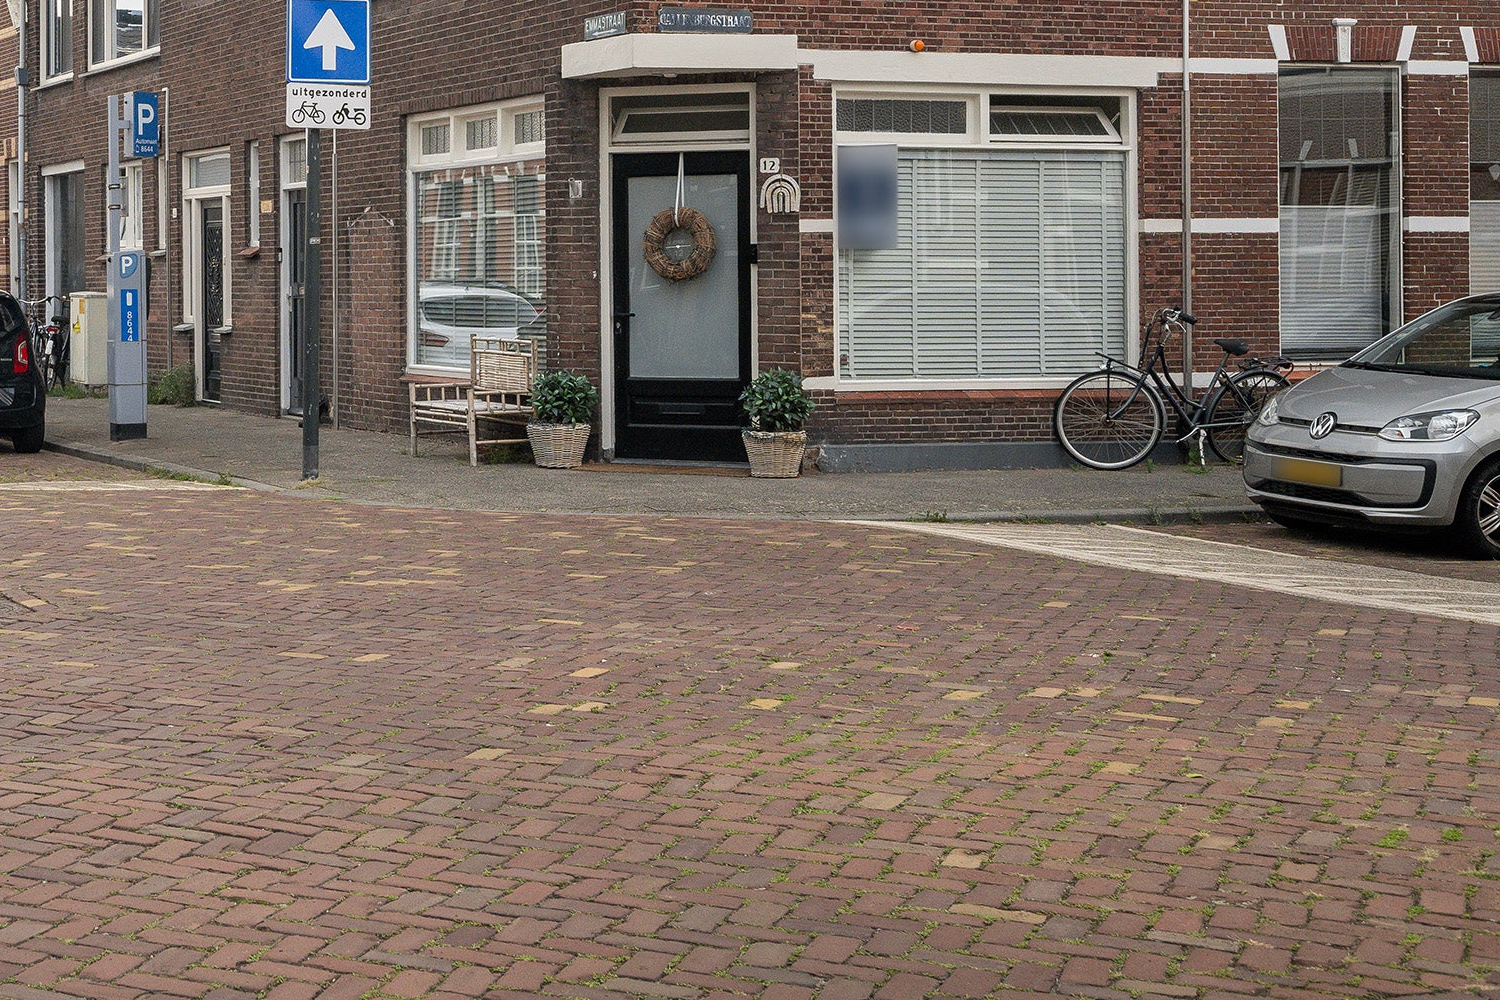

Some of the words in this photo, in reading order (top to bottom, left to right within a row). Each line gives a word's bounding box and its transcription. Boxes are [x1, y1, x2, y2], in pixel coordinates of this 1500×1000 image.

[586, 13, 626, 31] EMMASTRAAT
[292, 87, 367, 99] uitgezonderd
[138, 103, 155, 135] P
[763, 160, 776, 170] 12
[121, 256, 133, 274] P
[1310, 413, 1334, 438] VW
